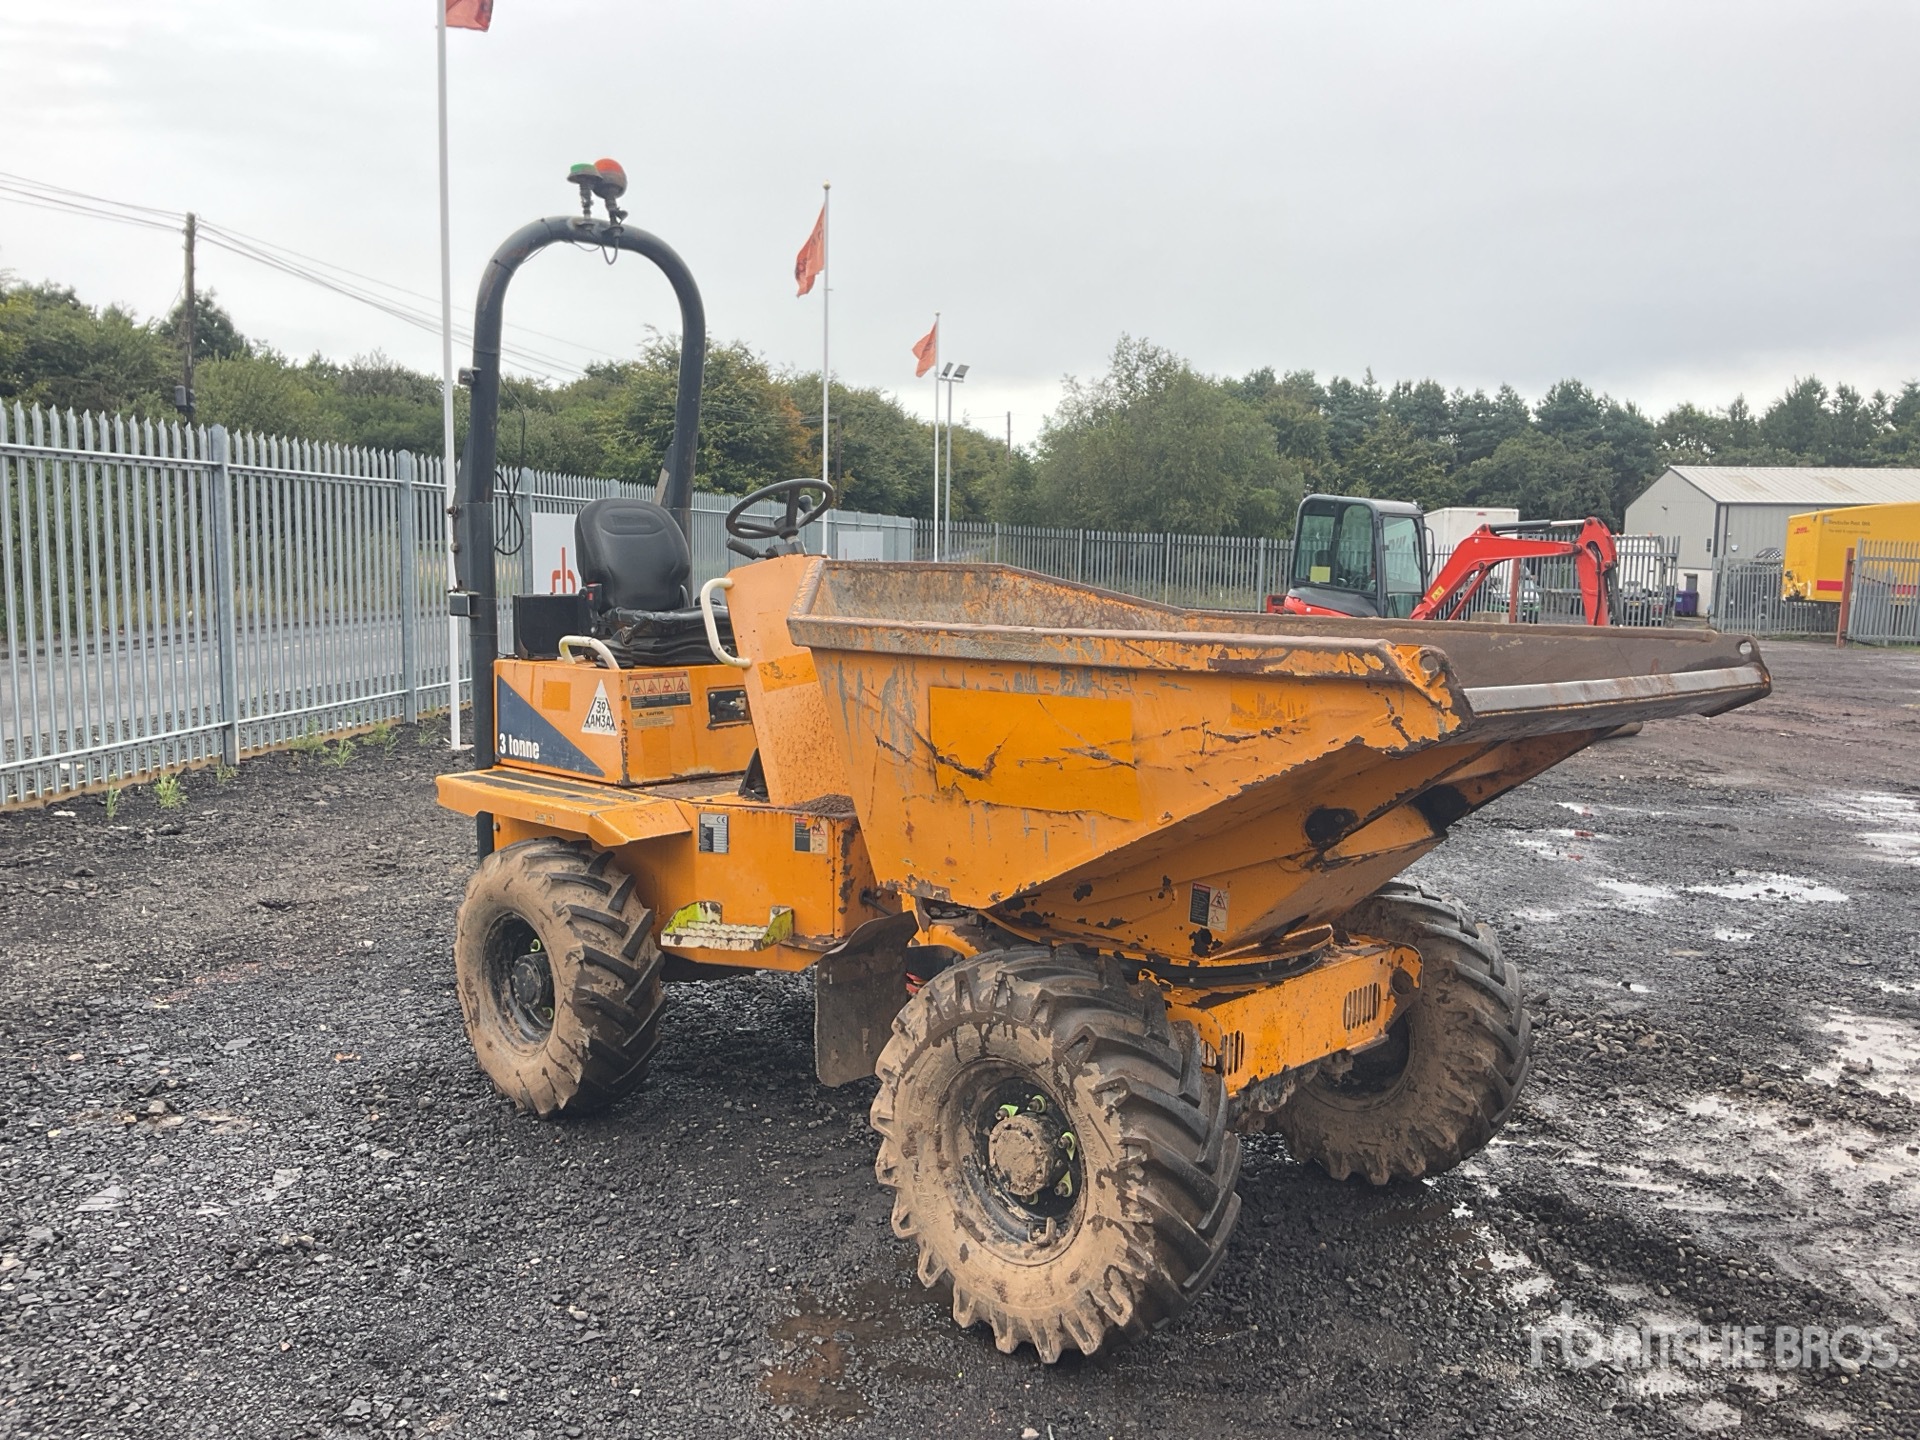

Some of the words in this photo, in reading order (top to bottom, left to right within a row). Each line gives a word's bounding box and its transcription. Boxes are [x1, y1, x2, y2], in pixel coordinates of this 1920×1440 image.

[595, 701, 606, 714] 39
[499, 732, 507, 755] 3
[509, 733, 540, 760] tonne
